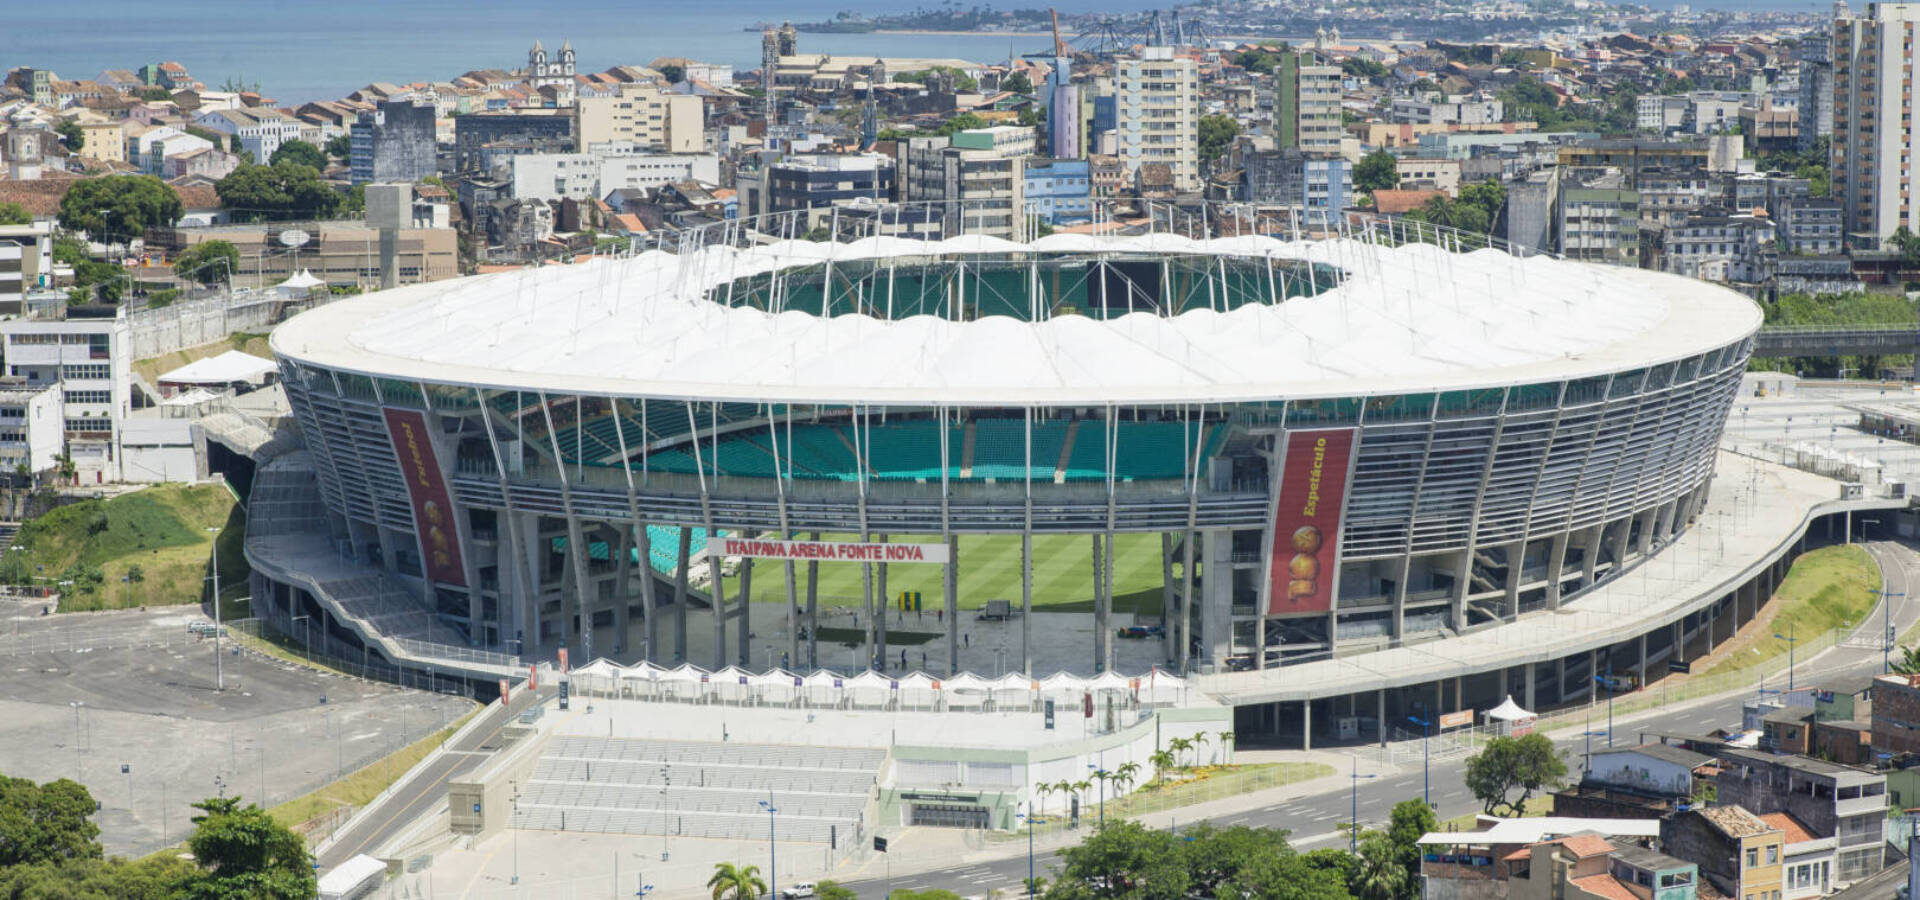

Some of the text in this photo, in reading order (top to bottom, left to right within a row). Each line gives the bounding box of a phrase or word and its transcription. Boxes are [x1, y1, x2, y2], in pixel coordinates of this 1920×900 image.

[1303, 437, 1327, 517] Espetáculo
[726, 540, 923, 560] ITAIPAVA ARENA FONTE NOVA
